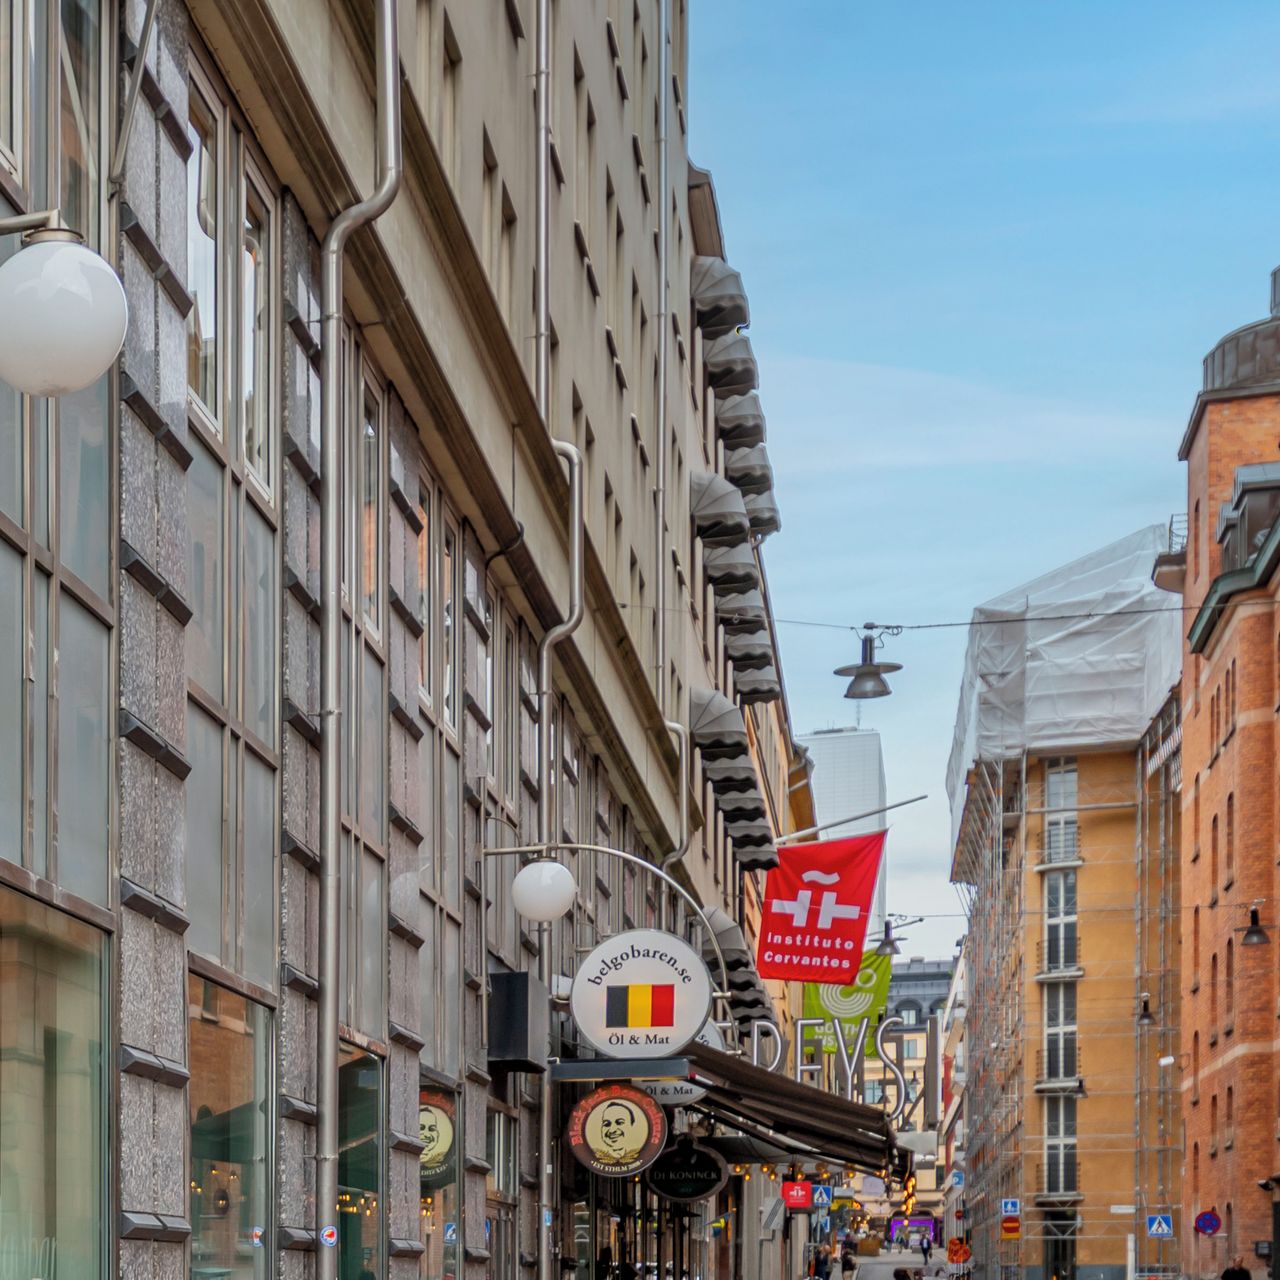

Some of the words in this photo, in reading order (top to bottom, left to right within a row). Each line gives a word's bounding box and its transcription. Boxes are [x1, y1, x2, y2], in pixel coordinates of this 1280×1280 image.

[767, 931, 855, 950] Instituto
[587, 944, 692, 986] belgobaren.se
[763, 950, 851, 969] Cervantes
[608, 1032, 624, 1045] Öl
[628, 1034, 640, 1045] &
[645, 1033, 670, 1045] Mat
[660, 1086, 670, 1096] &
[673, 1085, 693, 1096] Mat
